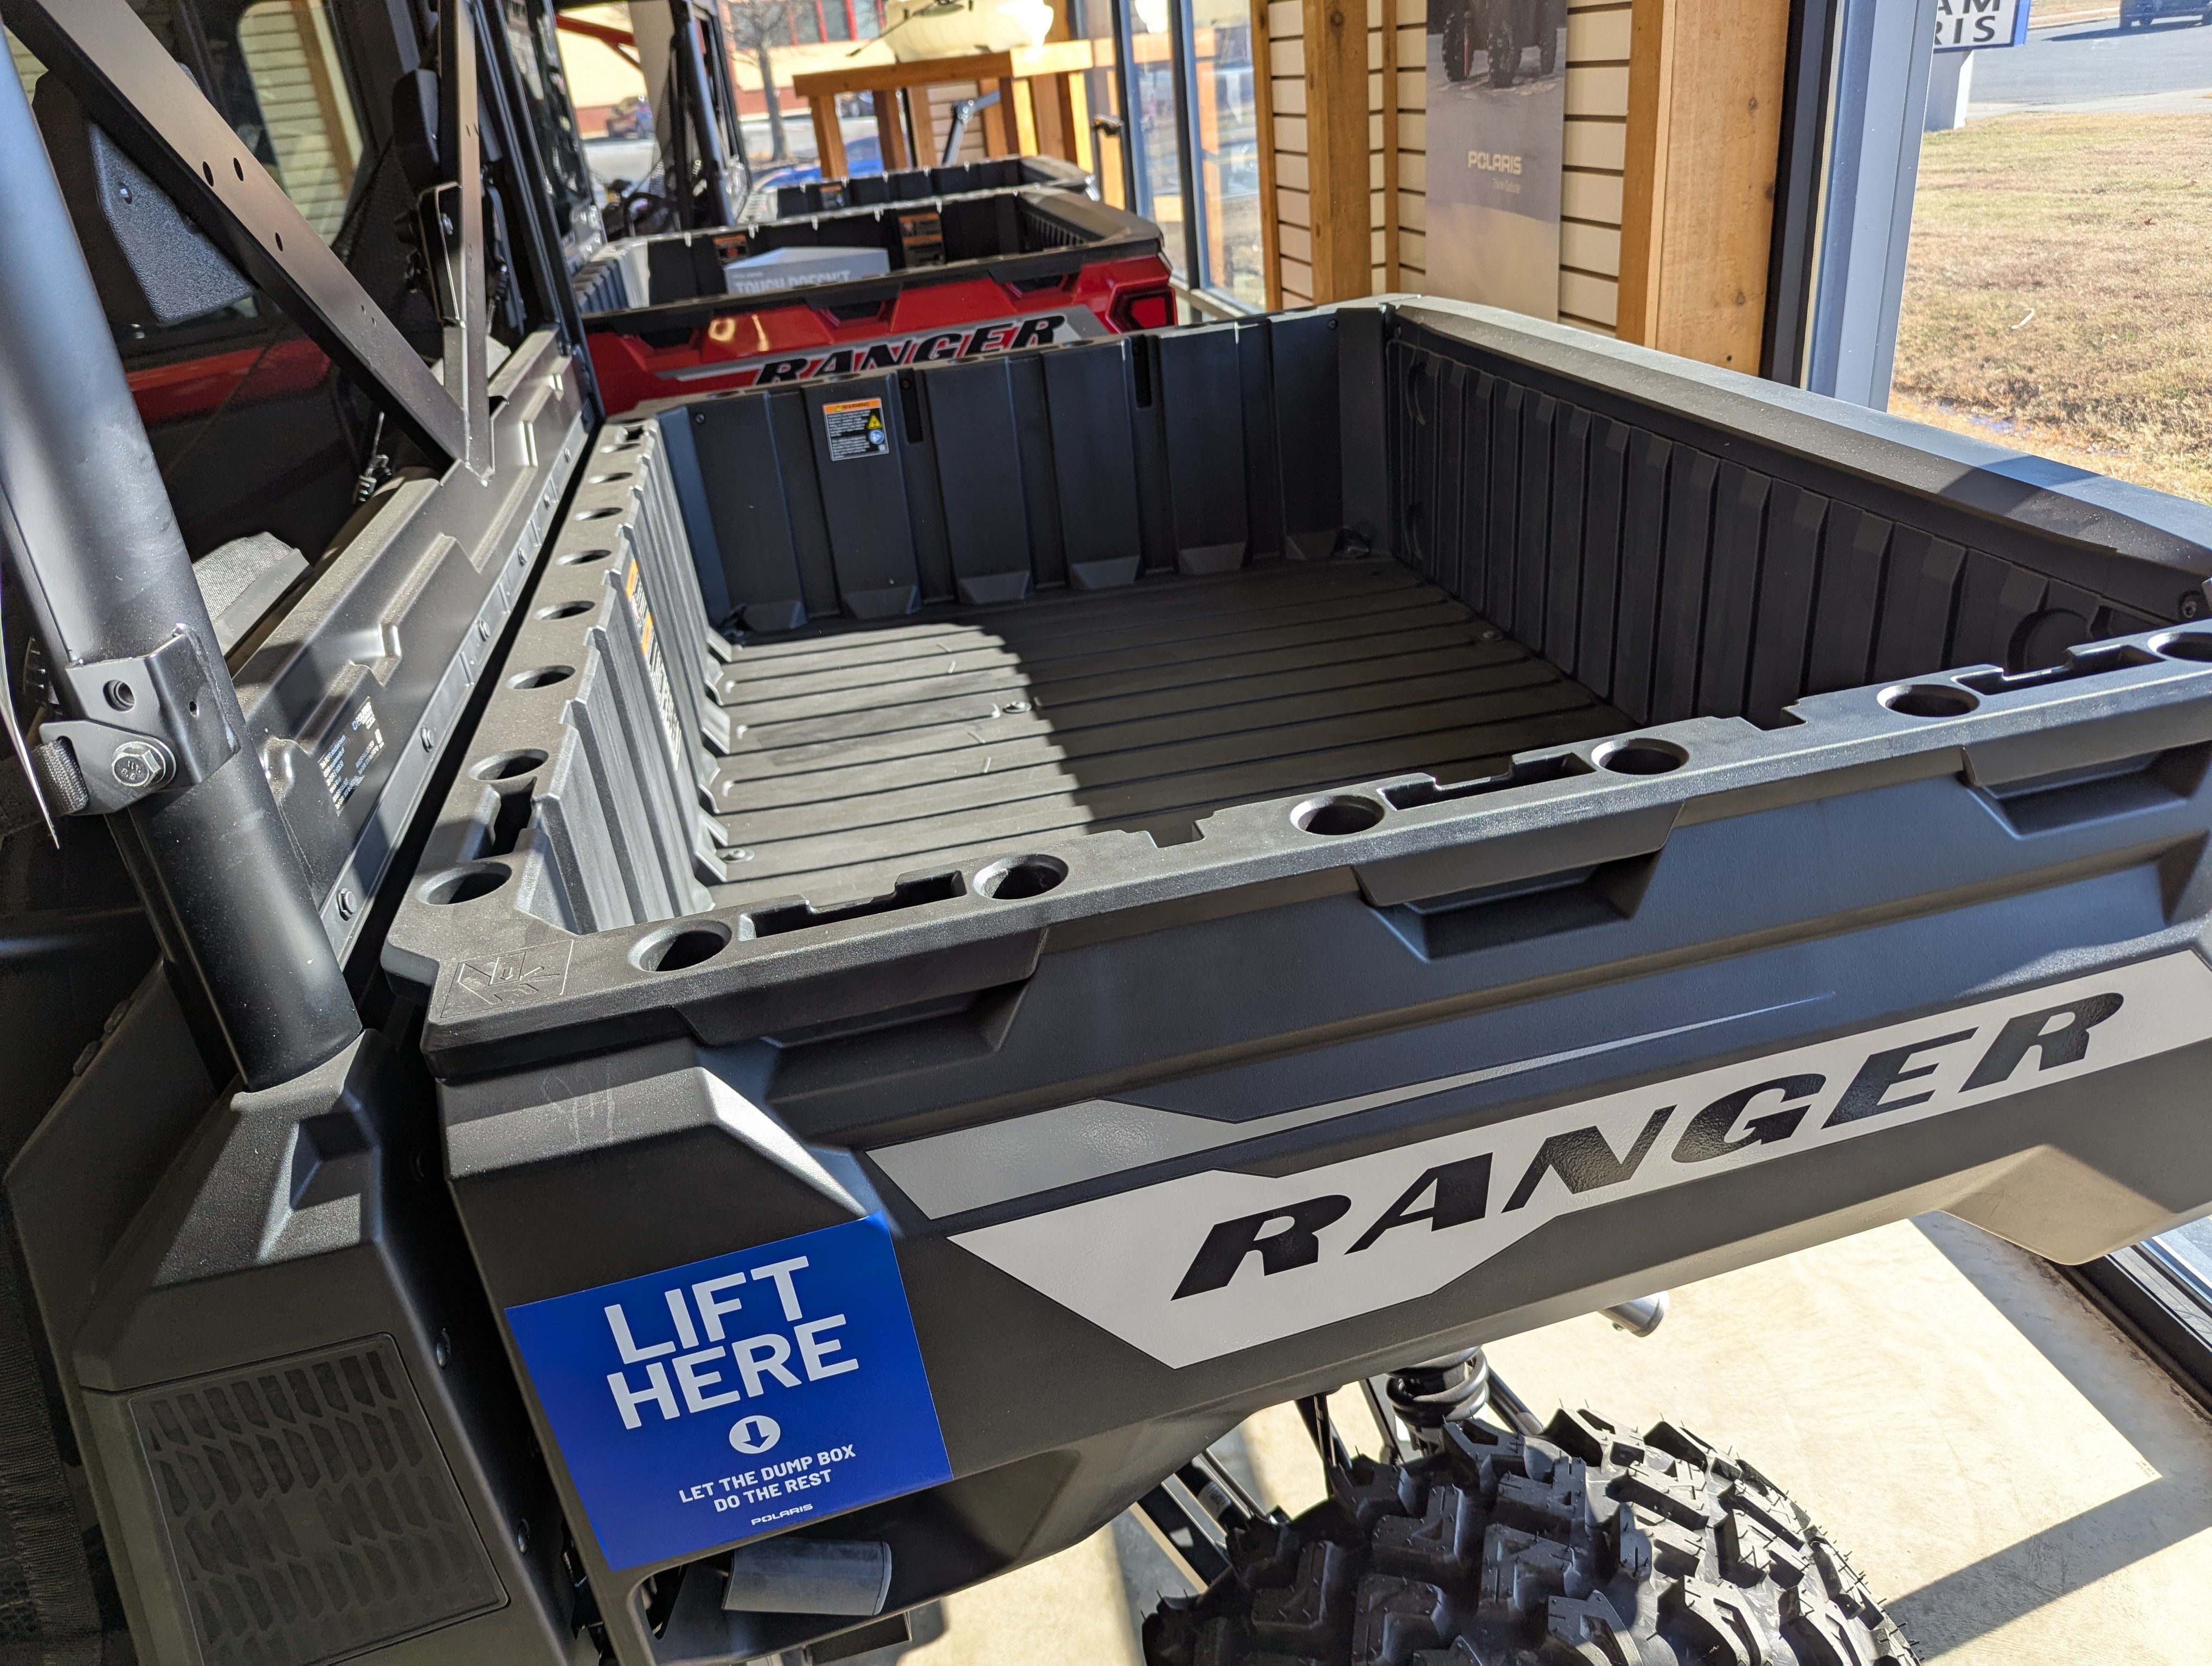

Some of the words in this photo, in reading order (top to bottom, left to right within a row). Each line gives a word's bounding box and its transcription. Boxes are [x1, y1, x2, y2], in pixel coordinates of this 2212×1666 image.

[1468, 151, 1522, 175] POLARIS
[756, 313, 1067, 385] RANGER
[1170, 992, 2124, 1302] RANGER
[604, 1255, 809, 1364] LIFT
[607, 1313, 859, 1430] HERE
[679, 1482, 714, 1503] LET
[718, 1470, 758, 1491] THE
[761, 1456, 813, 1481] DUMP
[816, 1444, 857, 1466] BOX
[713, 1495, 740, 1512] DO
[743, 1483, 782, 1504] THE
[784, 1469, 832, 1494] REST
[751, 1503, 814, 1526] POLARIS
